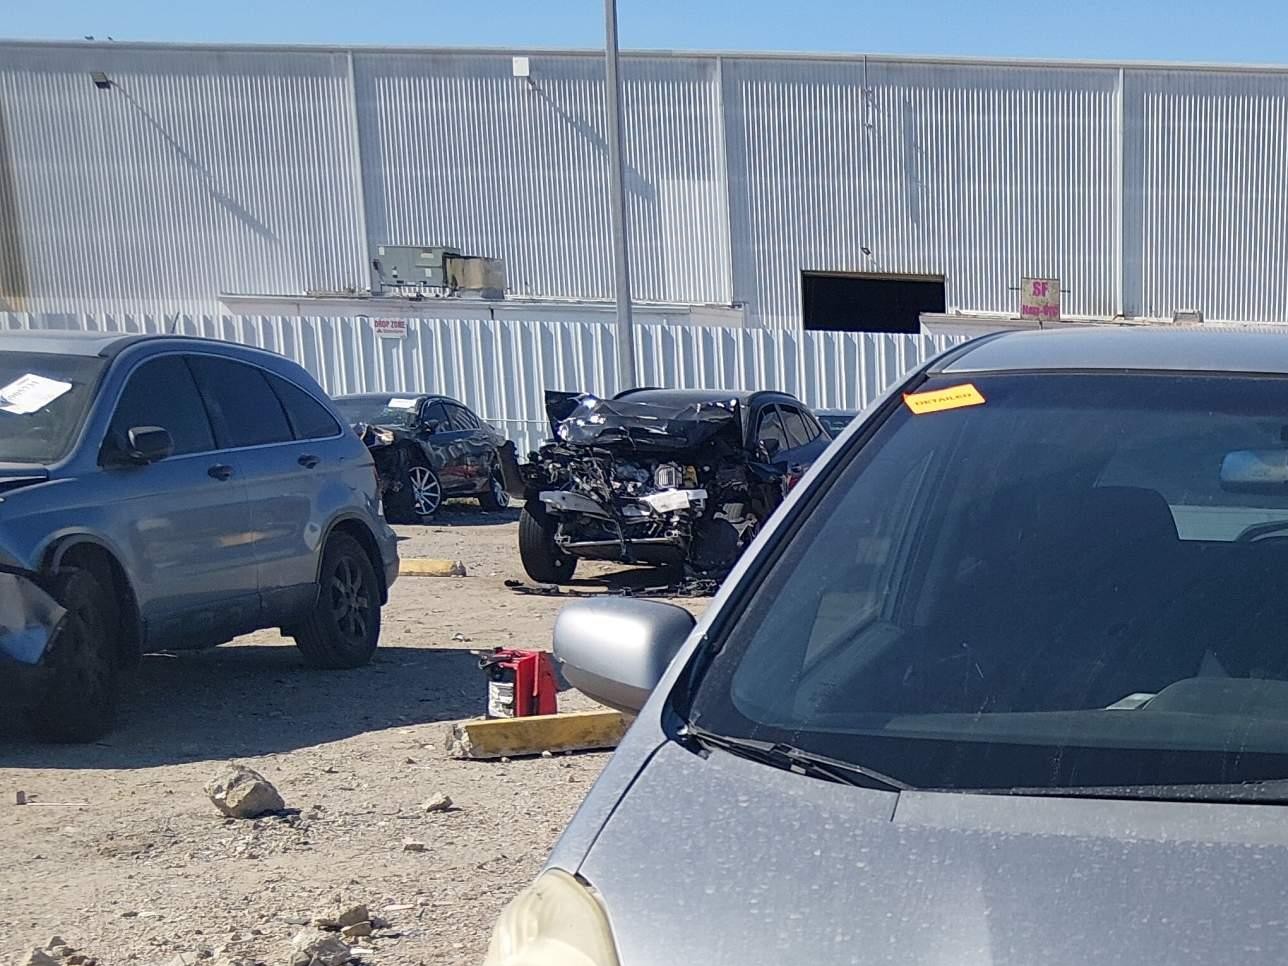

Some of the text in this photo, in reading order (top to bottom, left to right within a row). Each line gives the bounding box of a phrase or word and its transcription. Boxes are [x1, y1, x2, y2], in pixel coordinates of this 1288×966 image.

[1032, 281, 1048, 297] SF
[374, 320, 405, 328] DROP ZONE
